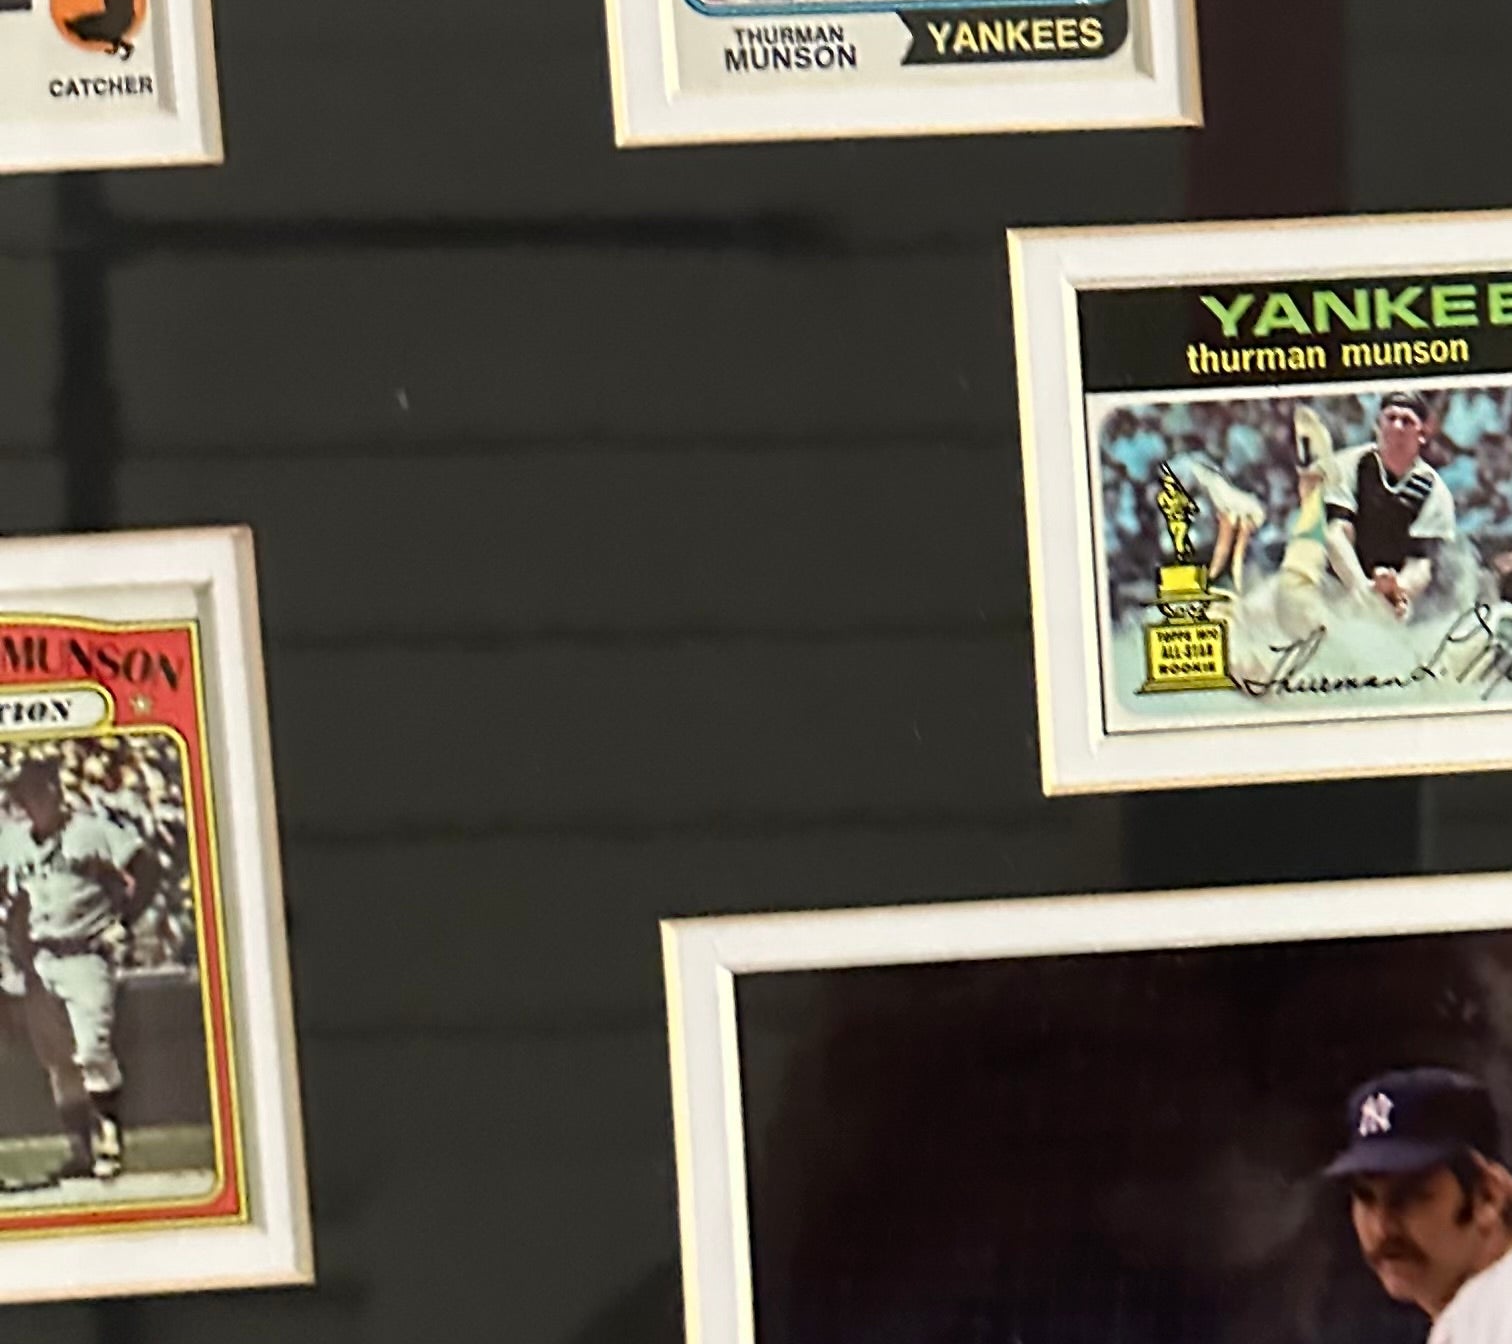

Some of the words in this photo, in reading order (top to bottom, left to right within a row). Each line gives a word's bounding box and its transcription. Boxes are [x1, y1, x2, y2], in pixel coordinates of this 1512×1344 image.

[733, 24, 845, 47] THURMAN
[927, 18, 1103, 57] YANKEES
[724, 44, 857, 72] MUNSON
[49, 75, 154, 97] CATCHER
[1187, 341, 1327, 375] thurman
[1341, 337, 1470, 368] munson
